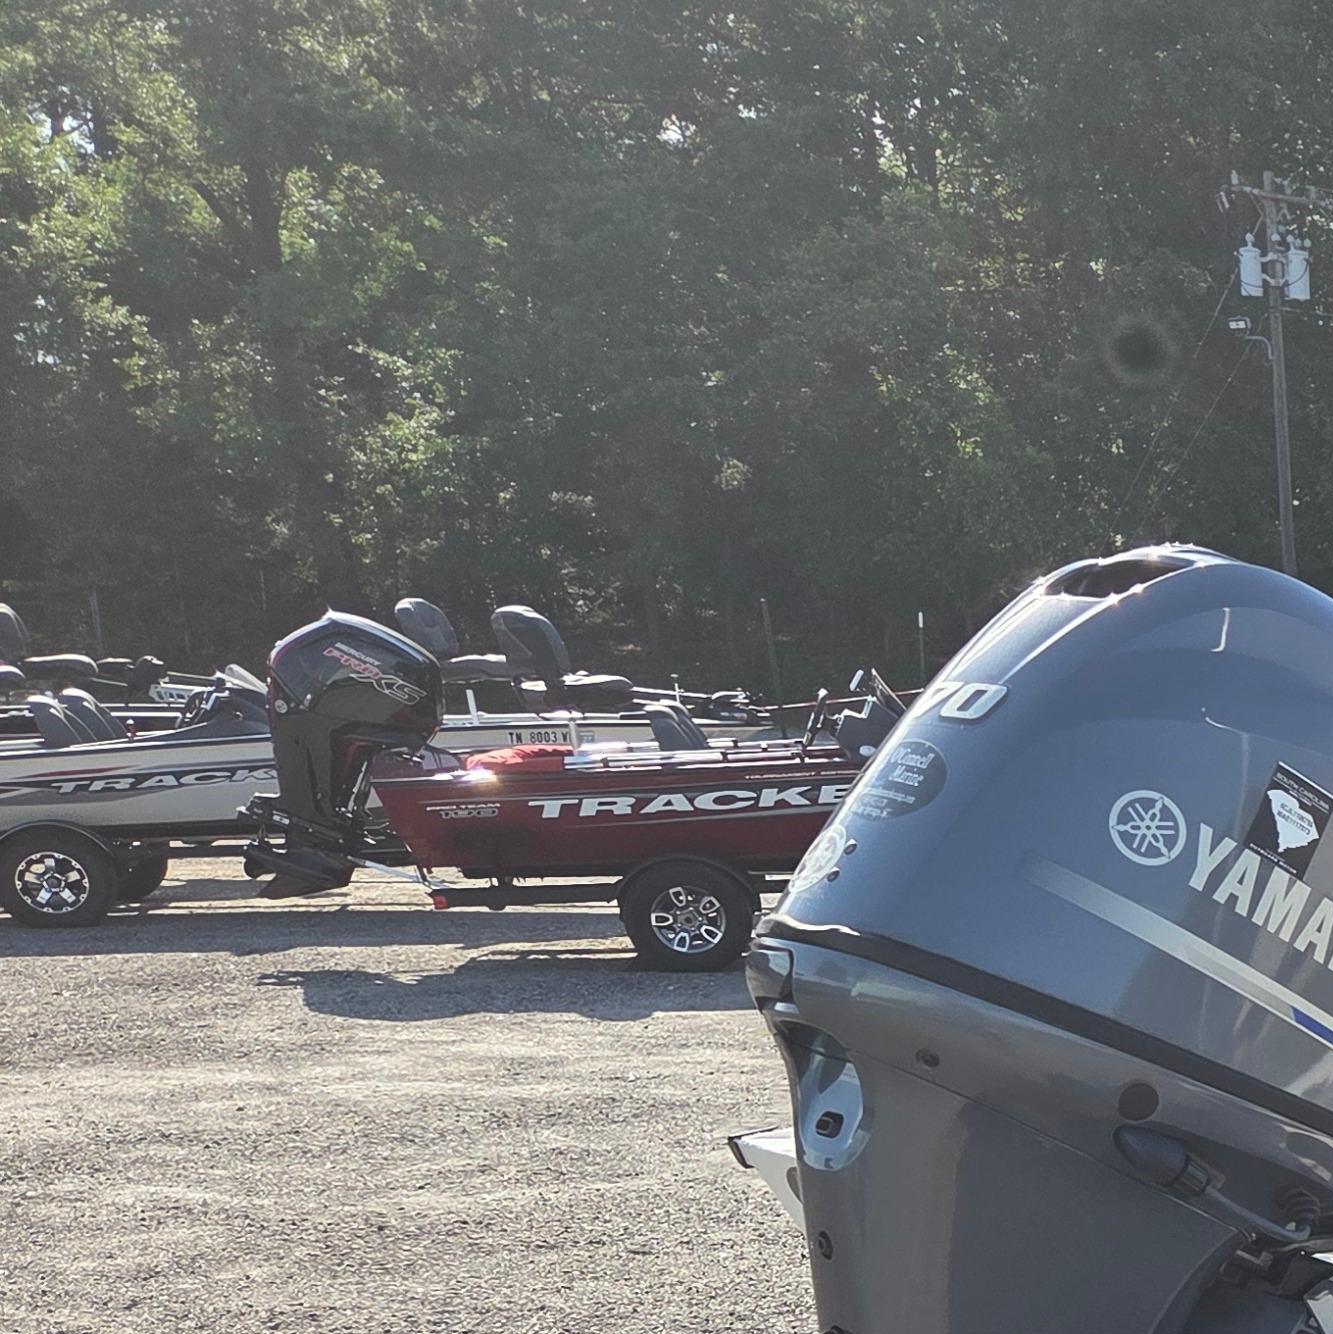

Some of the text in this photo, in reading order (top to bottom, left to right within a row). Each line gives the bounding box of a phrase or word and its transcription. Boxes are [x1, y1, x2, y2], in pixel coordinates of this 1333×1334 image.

[335, 642, 382, 667] MERCURY
[530, 731, 558, 743] 8003
[51, 768, 278, 794] TRACK
